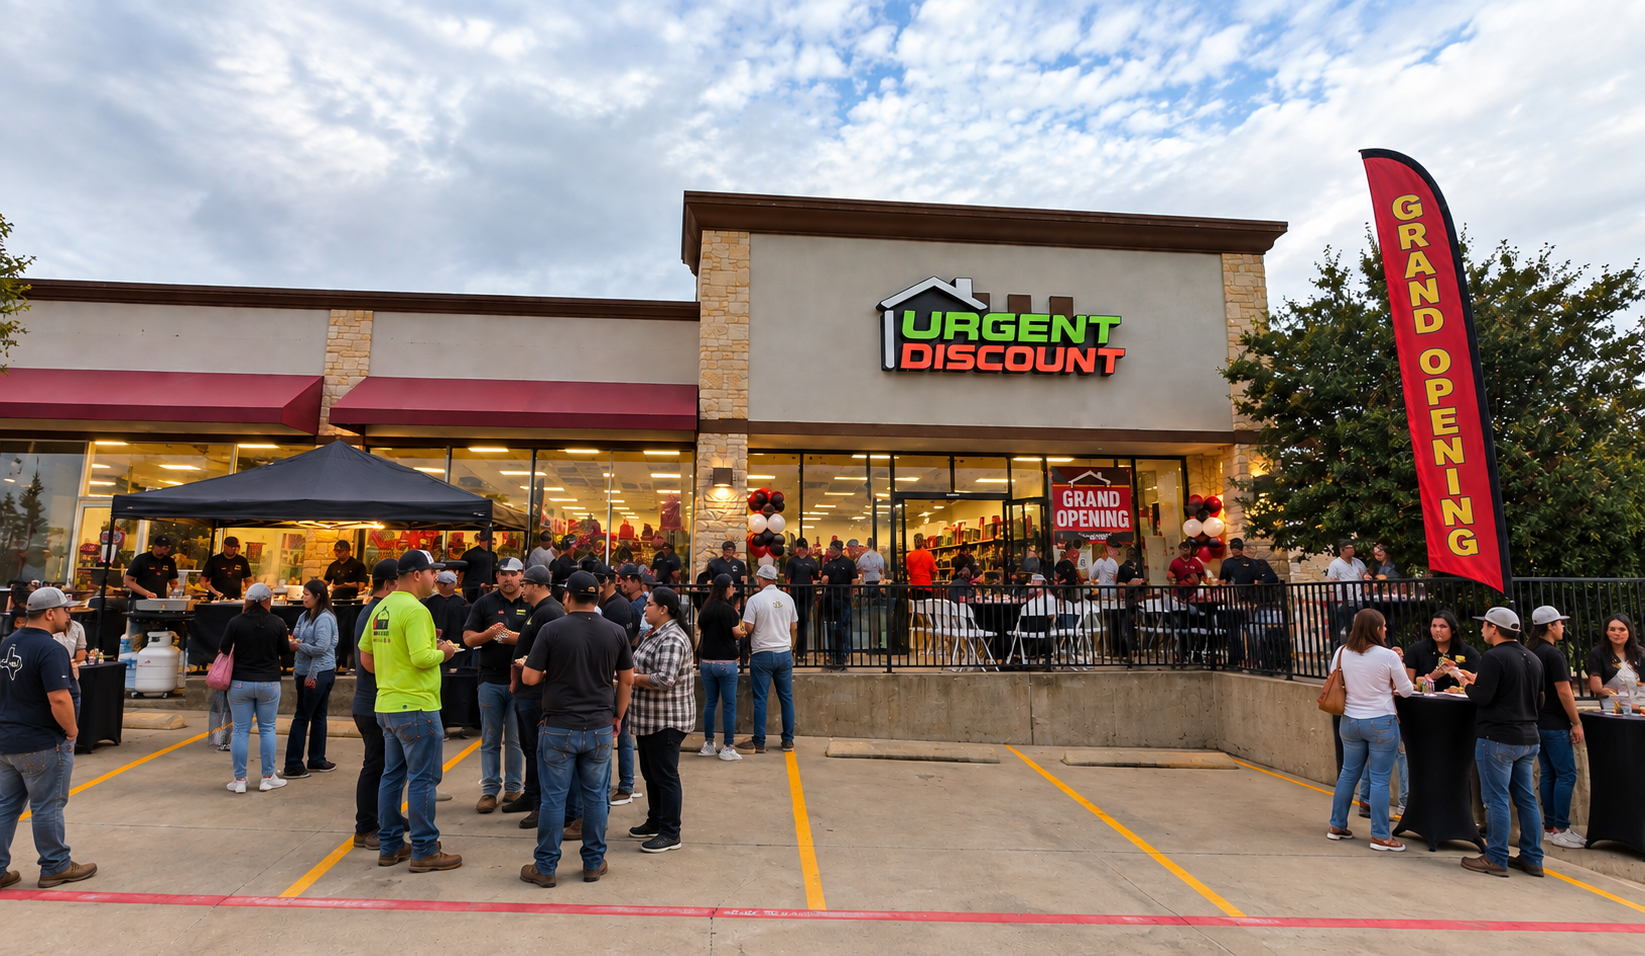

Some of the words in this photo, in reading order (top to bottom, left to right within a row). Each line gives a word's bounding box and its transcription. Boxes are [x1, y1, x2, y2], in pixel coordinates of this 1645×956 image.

[901, 309, 1122, 345] URGENT
[900, 342, 1126, 375] DISCOUNT
[1391, 194, 1445, 335] GRAND
[1418, 347, 1480, 557] OPENING
[1062, 490, 1120, 508] GRAND
[1056, 509, 1130, 528] OPENING
